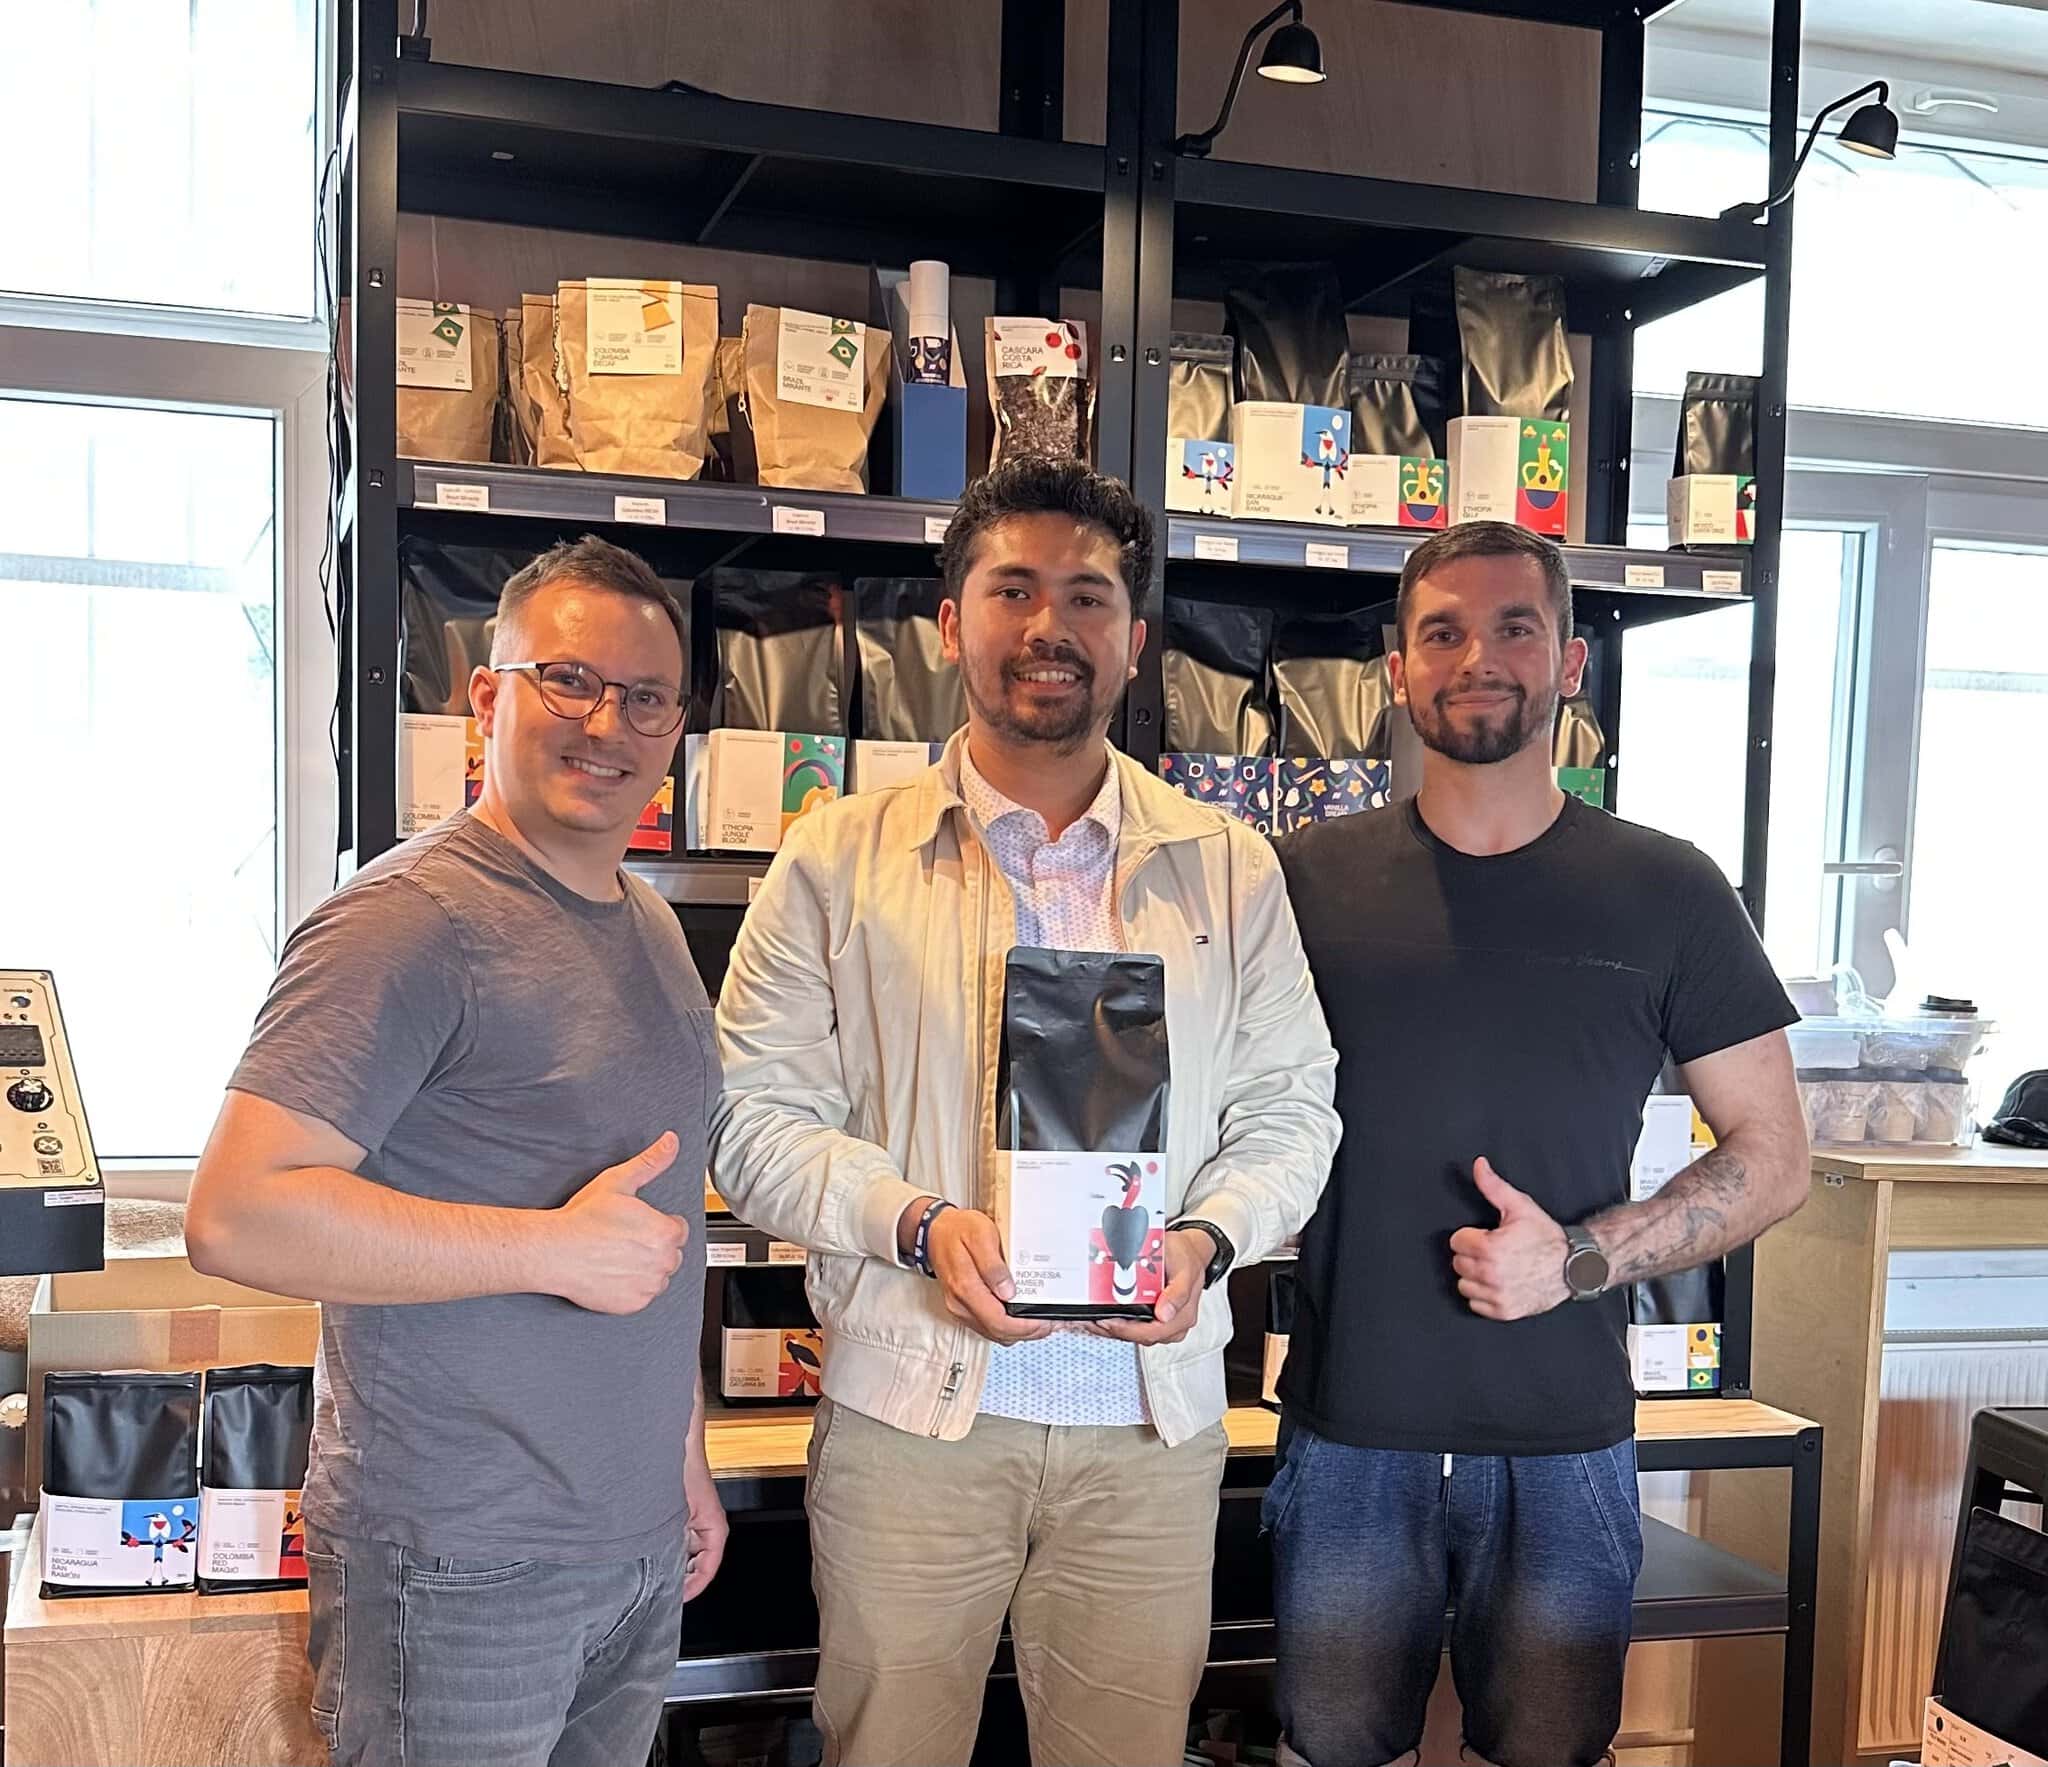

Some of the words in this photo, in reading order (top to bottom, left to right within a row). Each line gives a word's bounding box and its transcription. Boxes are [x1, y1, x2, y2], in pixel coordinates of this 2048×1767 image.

[1001, 346, 1044, 354] CASCARA
[1002, 353, 1032, 362] COSTA
[1002, 361, 1024, 369] RICA
[722, 823, 754, 831] ETHIOPIA
[1016, 1271, 1061, 1279] INDONESIA
[1016, 1279, 1044, 1288] AMBER
[51, 1558, 98, 1567] NICARAGUA
